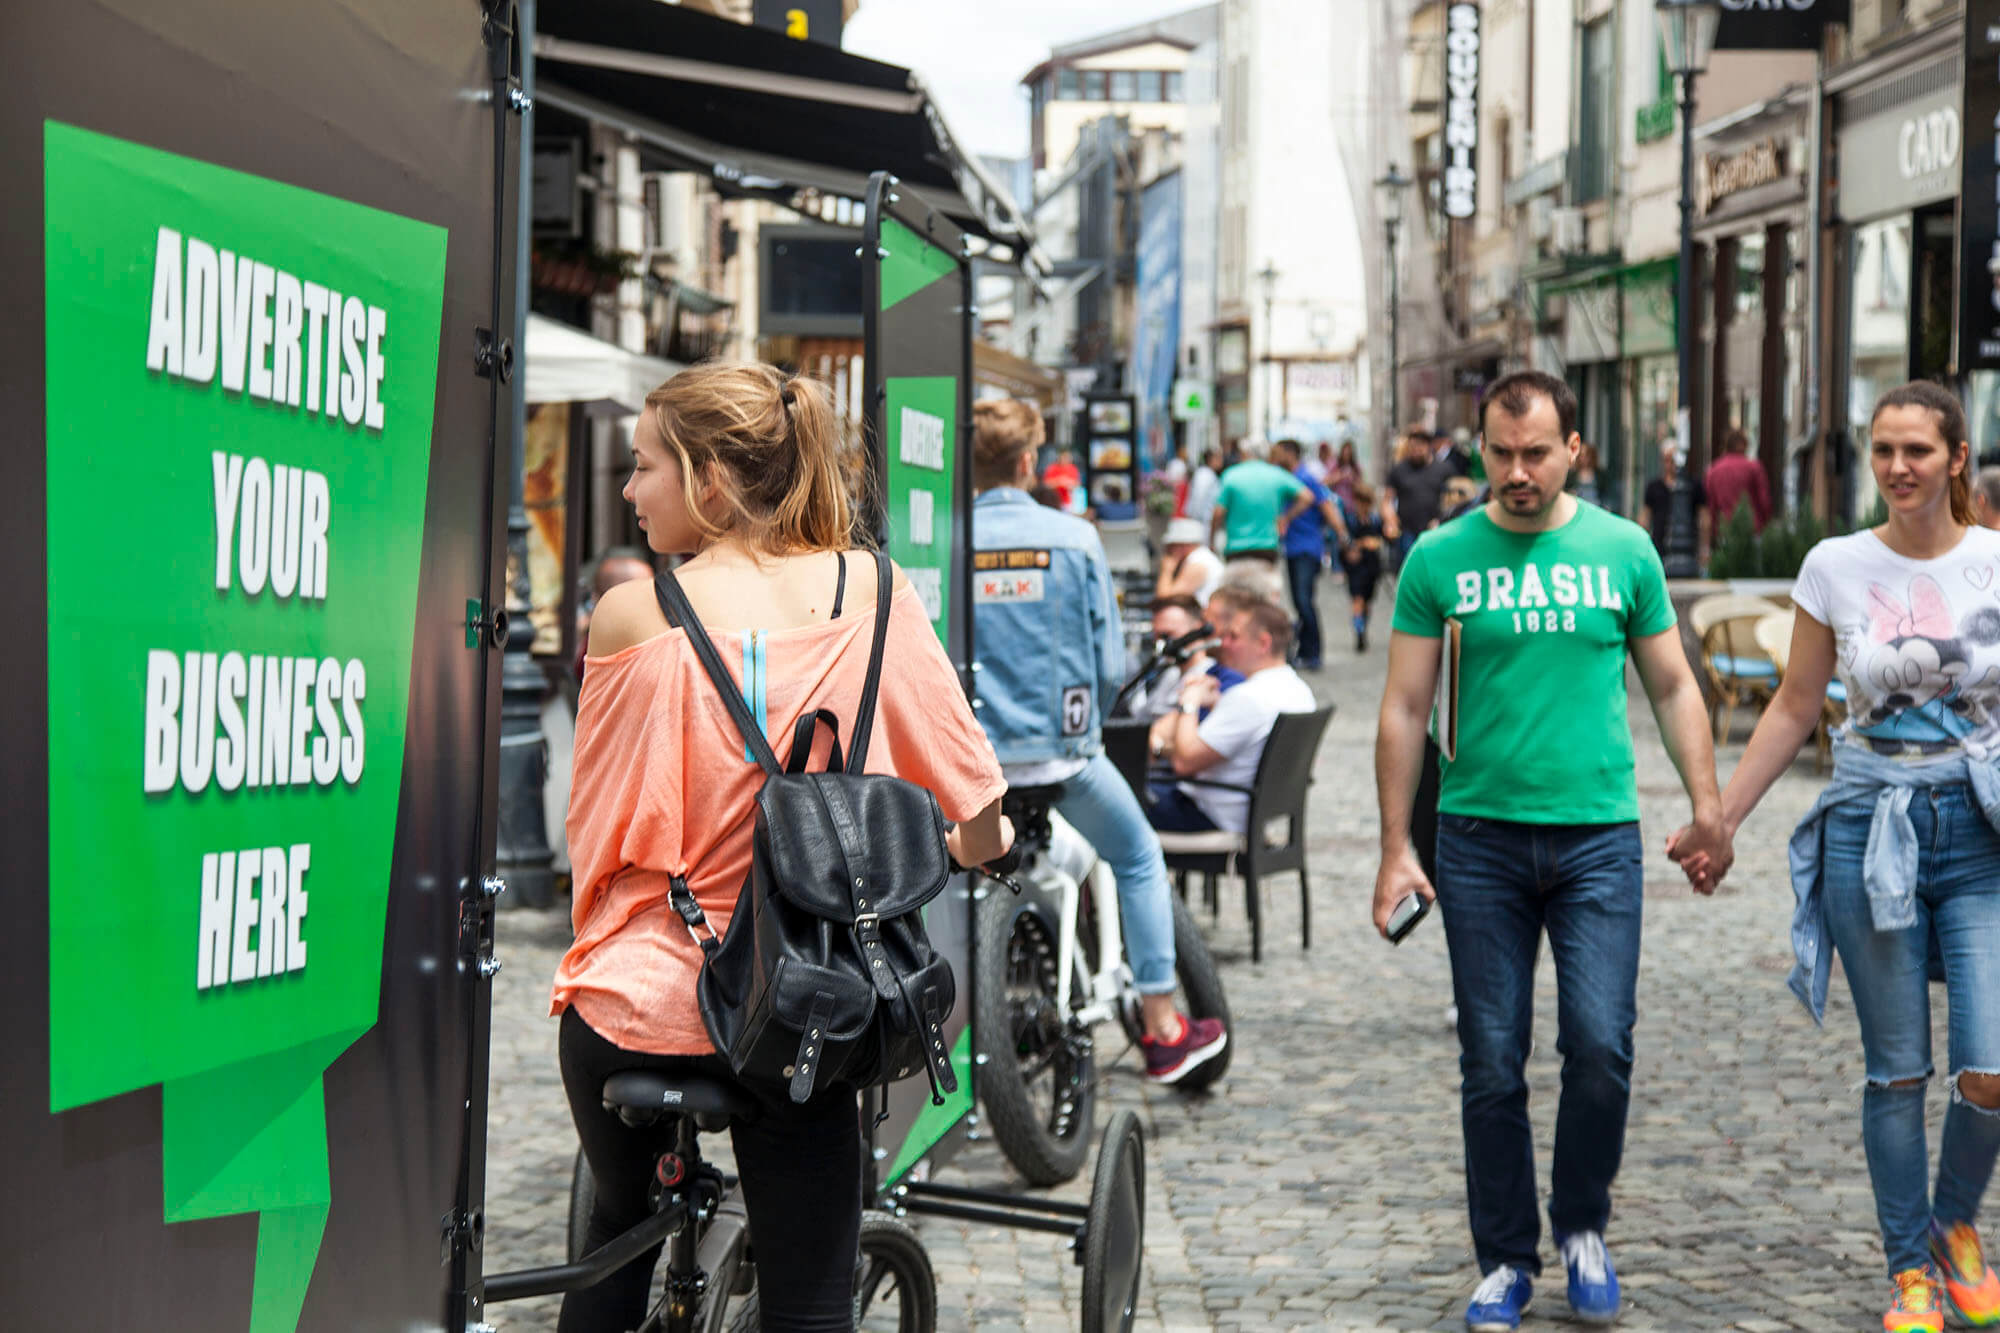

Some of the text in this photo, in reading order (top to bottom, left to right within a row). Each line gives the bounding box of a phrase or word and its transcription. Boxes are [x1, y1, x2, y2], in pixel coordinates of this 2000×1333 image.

[1447, 4, 1479, 217] SOUVENIRS
[1899, 106, 1960, 179] CATO
[147, 228, 386, 429] ADVERTISE
[212, 451, 329, 600] YOUR
[1456, 563, 1622, 614] BRASIL
[144, 650, 366, 793] BUSINESS
[197, 843, 310, 989] HERE
